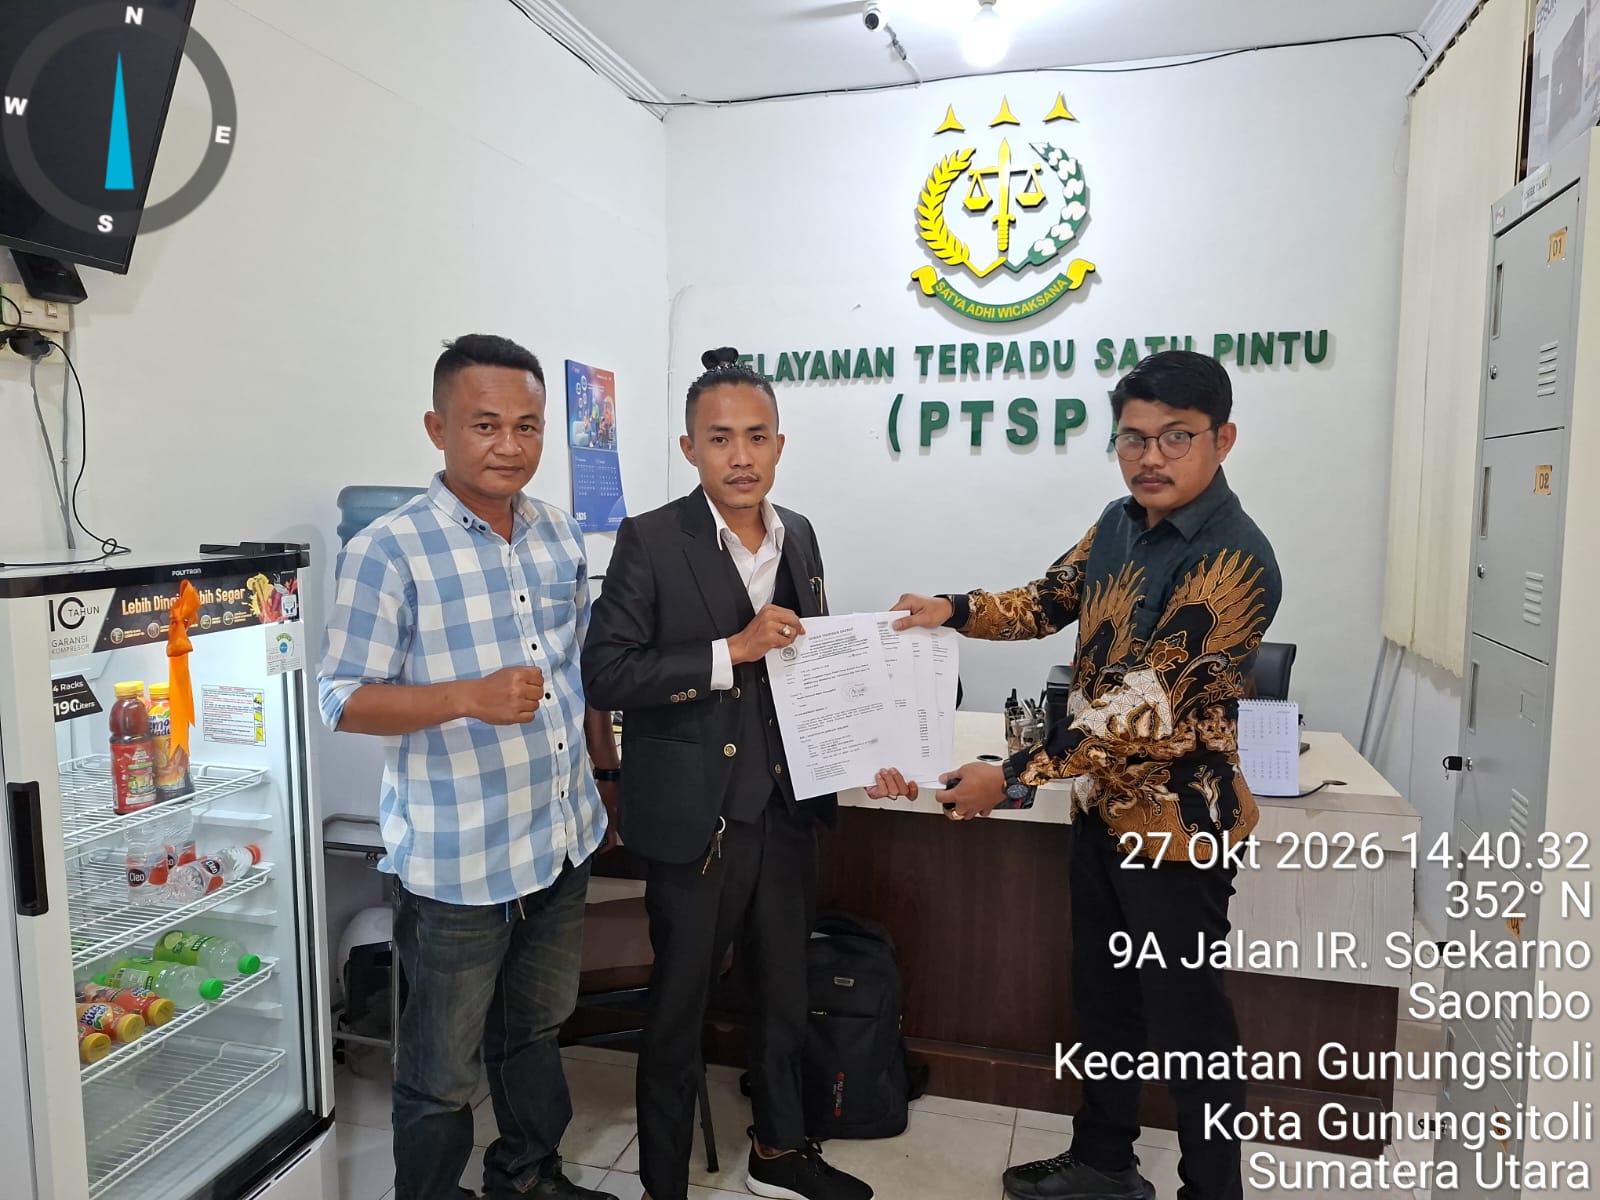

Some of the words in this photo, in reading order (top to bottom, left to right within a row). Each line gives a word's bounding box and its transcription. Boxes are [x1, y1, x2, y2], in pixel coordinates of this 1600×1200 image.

[1552, 237, 1563, 257] 01
[936, 281, 967, 312] SATYA
[966, 305, 995, 318] ADHI
[997, 278, 1068, 318] WICAKSANA
[737, 346, 895, 383] ELAYANAN
[915, 338, 1075, 377] TERPADU
[1213, 329, 1328, 367] PINTU
[121, 595, 153, 616] Lebih
[215, 586, 247, 605] Segar
[68, 606, 100, 617] TAHUN
[51, 634, 88, 648] GARANSI
[60, 681, 84, 691] Racks
[75, 701, 96, 711] Liters
